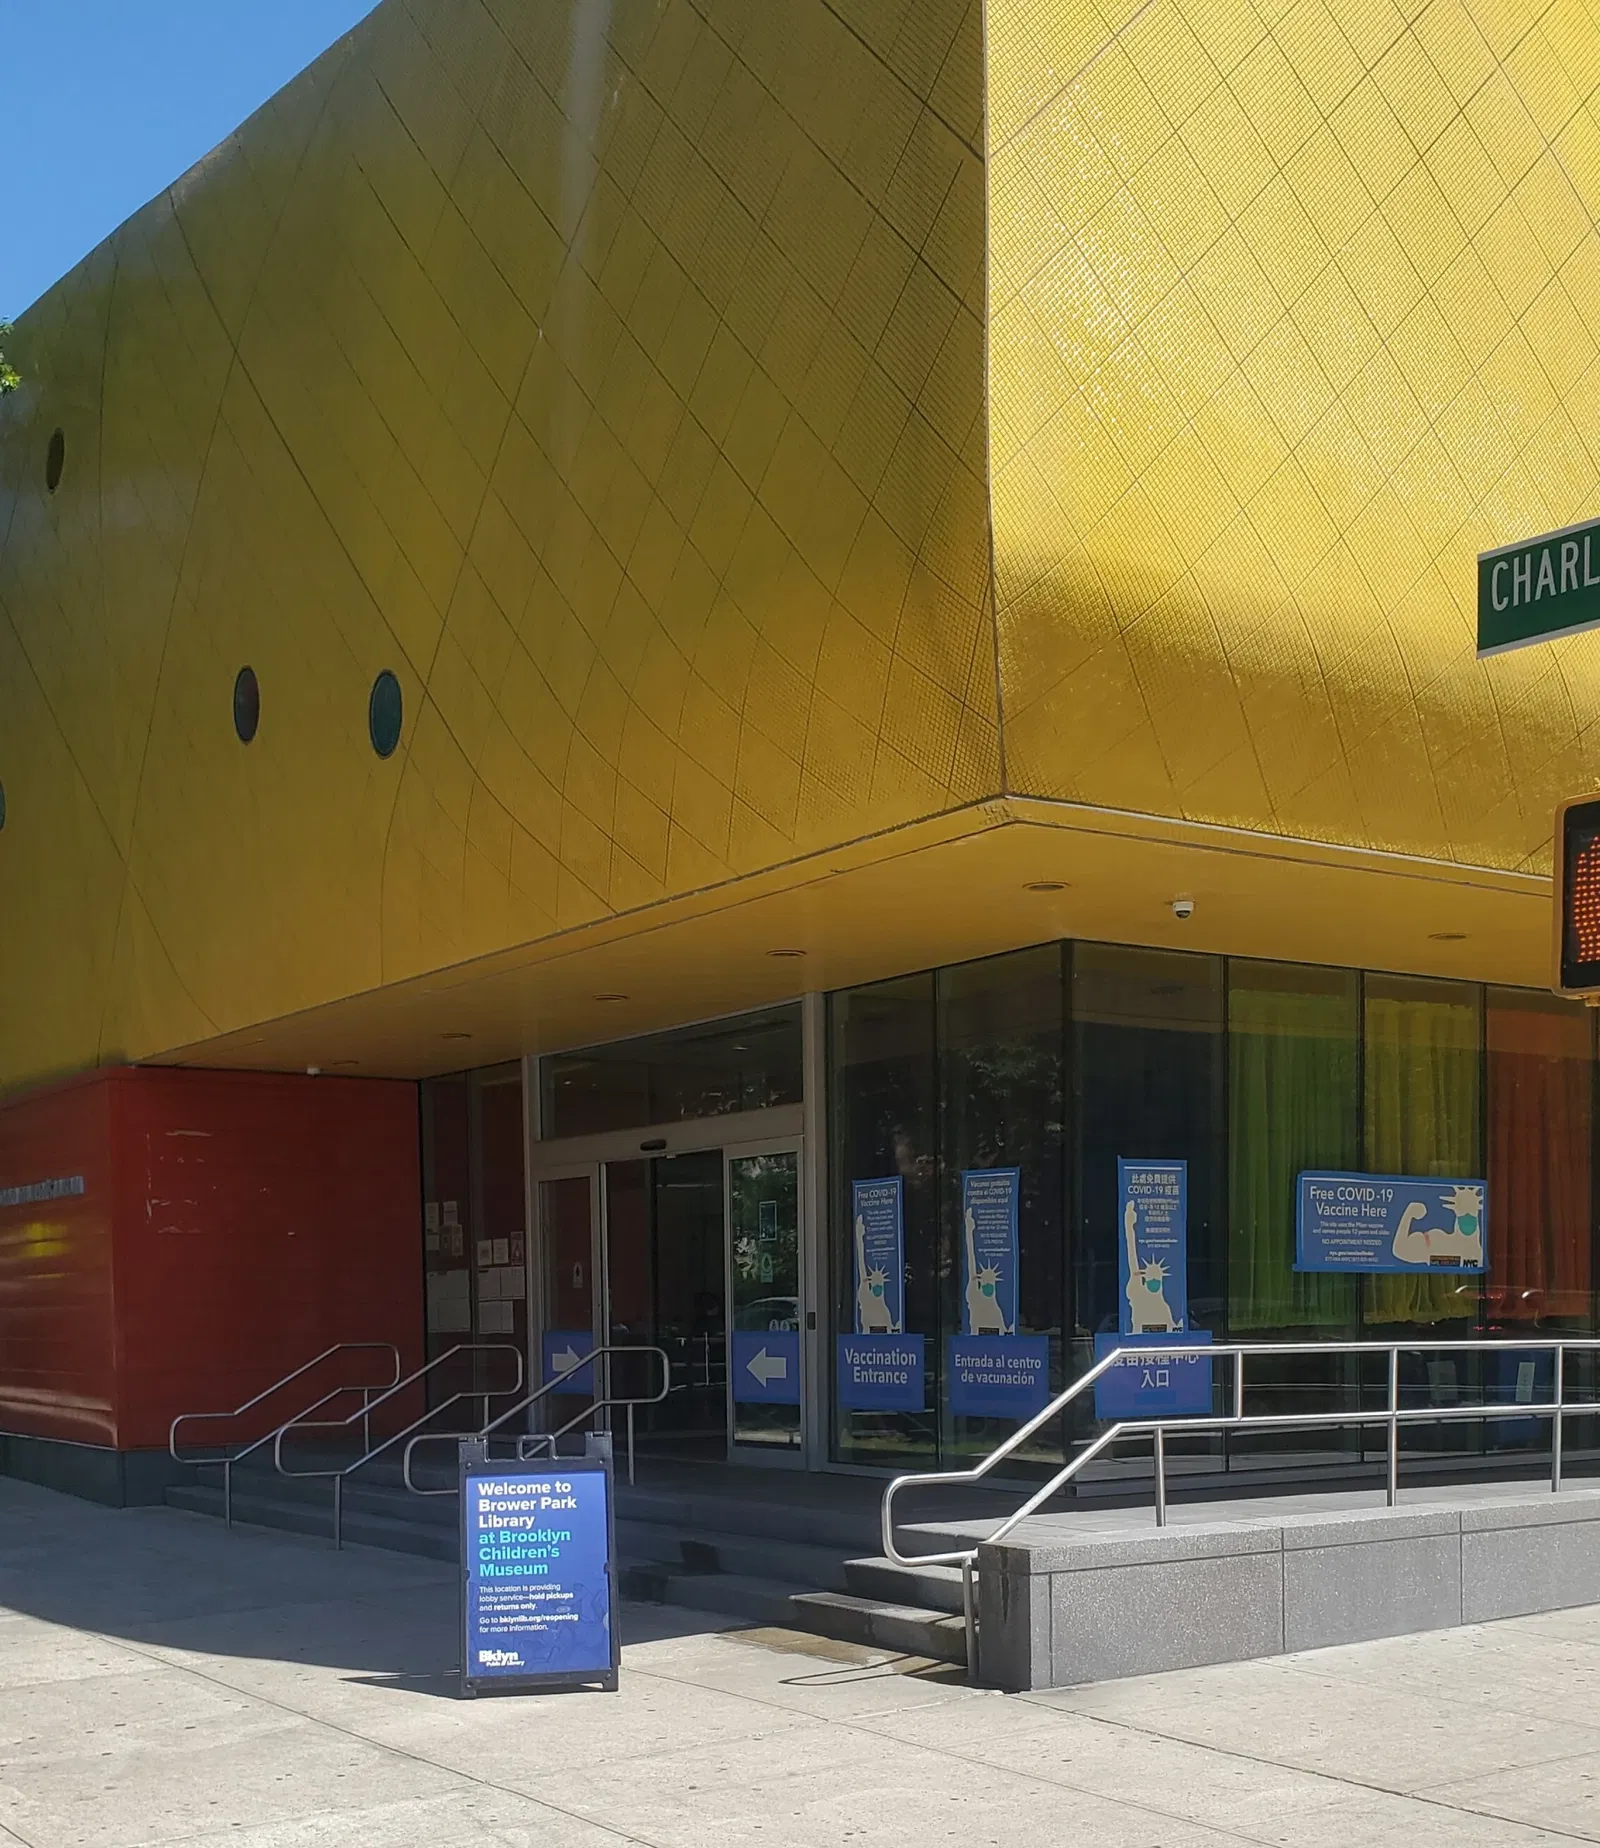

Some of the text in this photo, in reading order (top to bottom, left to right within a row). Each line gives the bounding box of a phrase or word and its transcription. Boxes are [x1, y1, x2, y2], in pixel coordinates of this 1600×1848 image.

[1491, 536, 1600, 611] CHARL
[858, 1187, 897, 1199] Free COVID-19
[989, 1187, 1013, 1197] COVID-19
[1128, 1185, 1180, 1196] COVID-19 疫苗
[1310, 1186, 1394, 1203] Free COVID-19
[860, 1197, 894, 1207] Vaccine Here
[1316, 1202, 1388, 1218] Vaccine Here
[1463, 1259, 1479, 1268] NYC
[844, 1347, 917, 1366] Vaccination
[955, 1354, 1042, 1370] Entrada al centro
[853, 1367, 908, 1384] Entrance
[961, 1369, 1035, 1386] de vacunación
[1140, 1369, 1170, 1388] 入口
[478, 1480, 572, 1496] Welcome to
[479, 1496, 577, 1512] Brower Park
[479, 1514, 535, 1530] Library
[479, 1528, 572, 1544] at Brooklyn
[479, 1562, 548, 1577] Museum
[479, 1583, 561, 1594] This location is providing
[479, 1595, 498, 1603] lobby
[546, 1592, 574, 1601] pickups
[479, 1602, 538, 1612] and returns only.
[499, 1613, 579, 1624] bklynlib.org/reopening
[479, 1626, 490, 1634] for
[509, 1624, 550, 1633] information.
[478, 1649, 519, 1666] Bklyn
